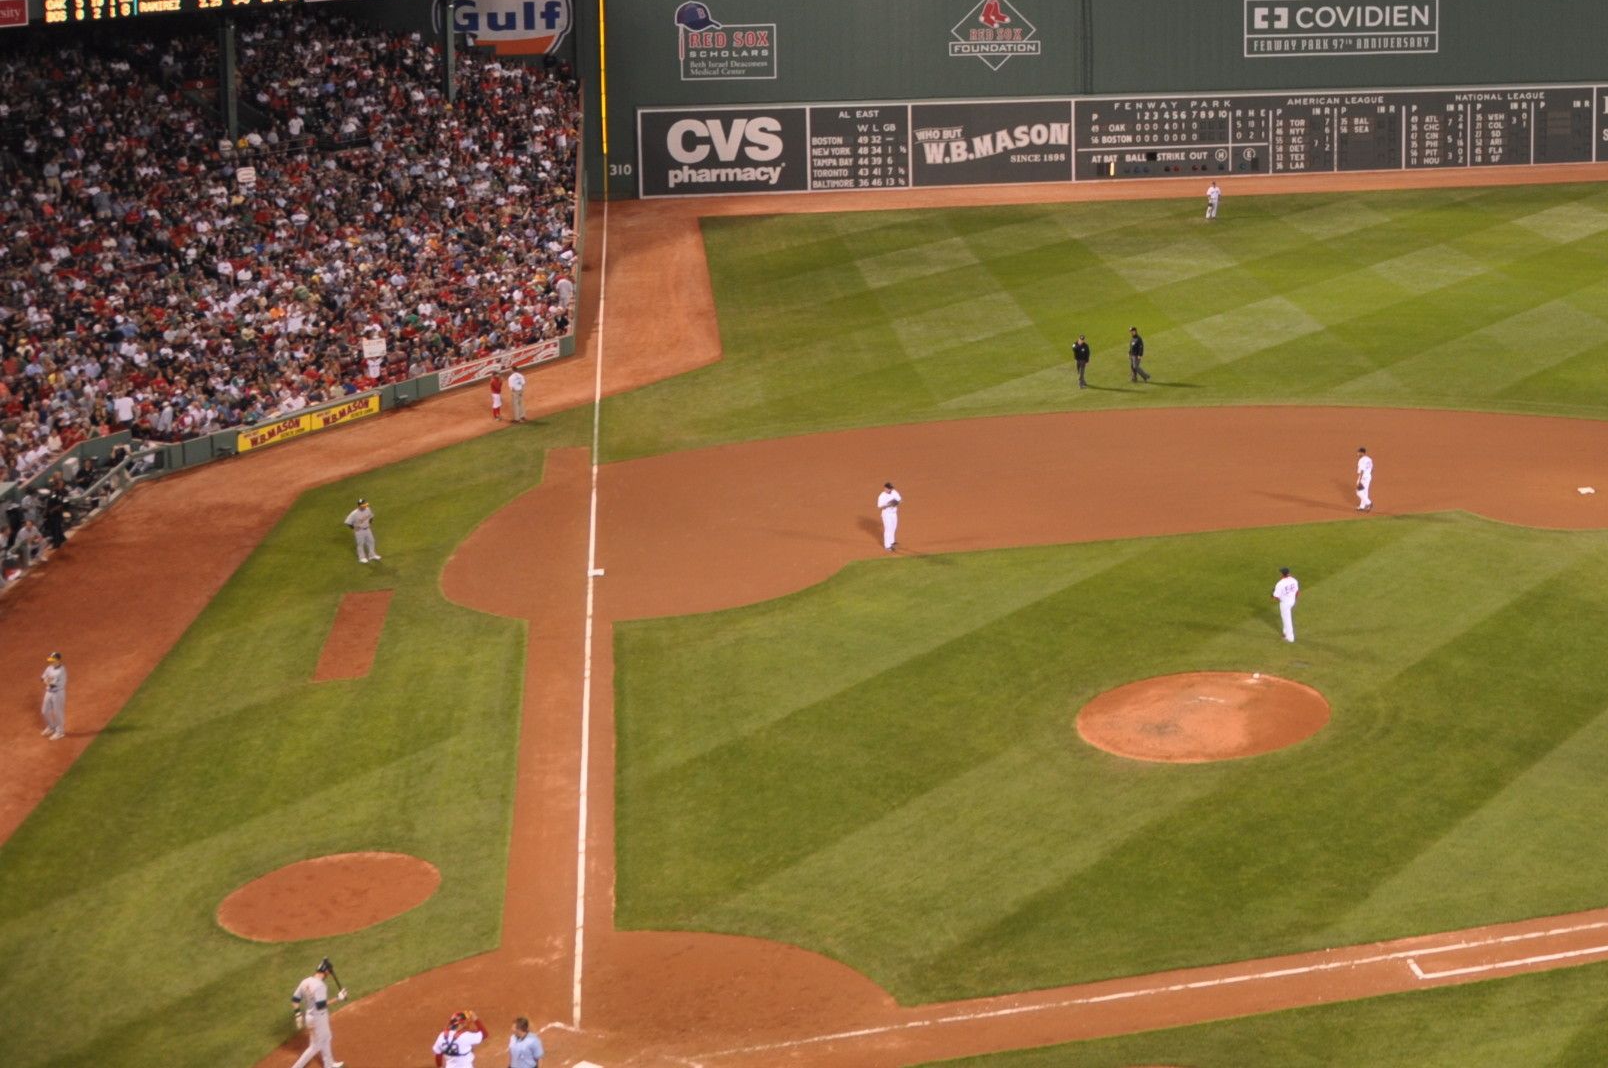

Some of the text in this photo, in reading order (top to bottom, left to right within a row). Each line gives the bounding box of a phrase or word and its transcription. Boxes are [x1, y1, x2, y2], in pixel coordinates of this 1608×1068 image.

[1295, 5, 1430, 29] COVIDIEN
[688, 31, 770, 48] RED SOX
[969, 28, 1023, 41] RED SOX
[954, 43, 1036, 53] FOUNDATION
[1254, 38, 1297, 52] FENWAY
[1301, 38, 1329, 51] PARK
[1356, 36, 1430, 50] ANNIVERSARY
[689, 49, 769, 58] SCHOLARS
[708, 60, 728, 69] Israel
[690, 68, 719, 76] Medical
[1287, 96, 1384, 105] AMERICAN LEAGUE
[1455, 92, 1545, 101] NATIONAL LEAGUE
[1114, 100, 1231, 110] FENWAY PARK
[839, 110, 879, 119] AL EAST
[1425, 115, 1439, 123] ATL
[857, 123, 896, 132] W GB
[1108, 123, 1125, 132] OAK
[1290, 119, 1305, 127] TOR
[1423, 123, 1440, 131] CHC
[915, 128, 963, 141] WHO BUT
[1101, 135, 1133, 144] BOSTON
[666, 116, 783, 164] CVS
[812, 135, 881, 146] BOSTON 49 32
[812, 147, 829, 156] NEW
[831, 147, 851, 156] YORK
[812, 157, 869, 167] TAMPA BAY 44
[1010, 153, 1065, 163] SINCE 1898
[1091, 151, 1208, 164] AT BAT BALL STRIKE OUT
[609, 164, 632, 176] 310
[813, 167, 881, 178] TORONTO 43 41
[668, 165, 783, 188] pharmacy
[812, 179, 855, 189] BALTIMORE
